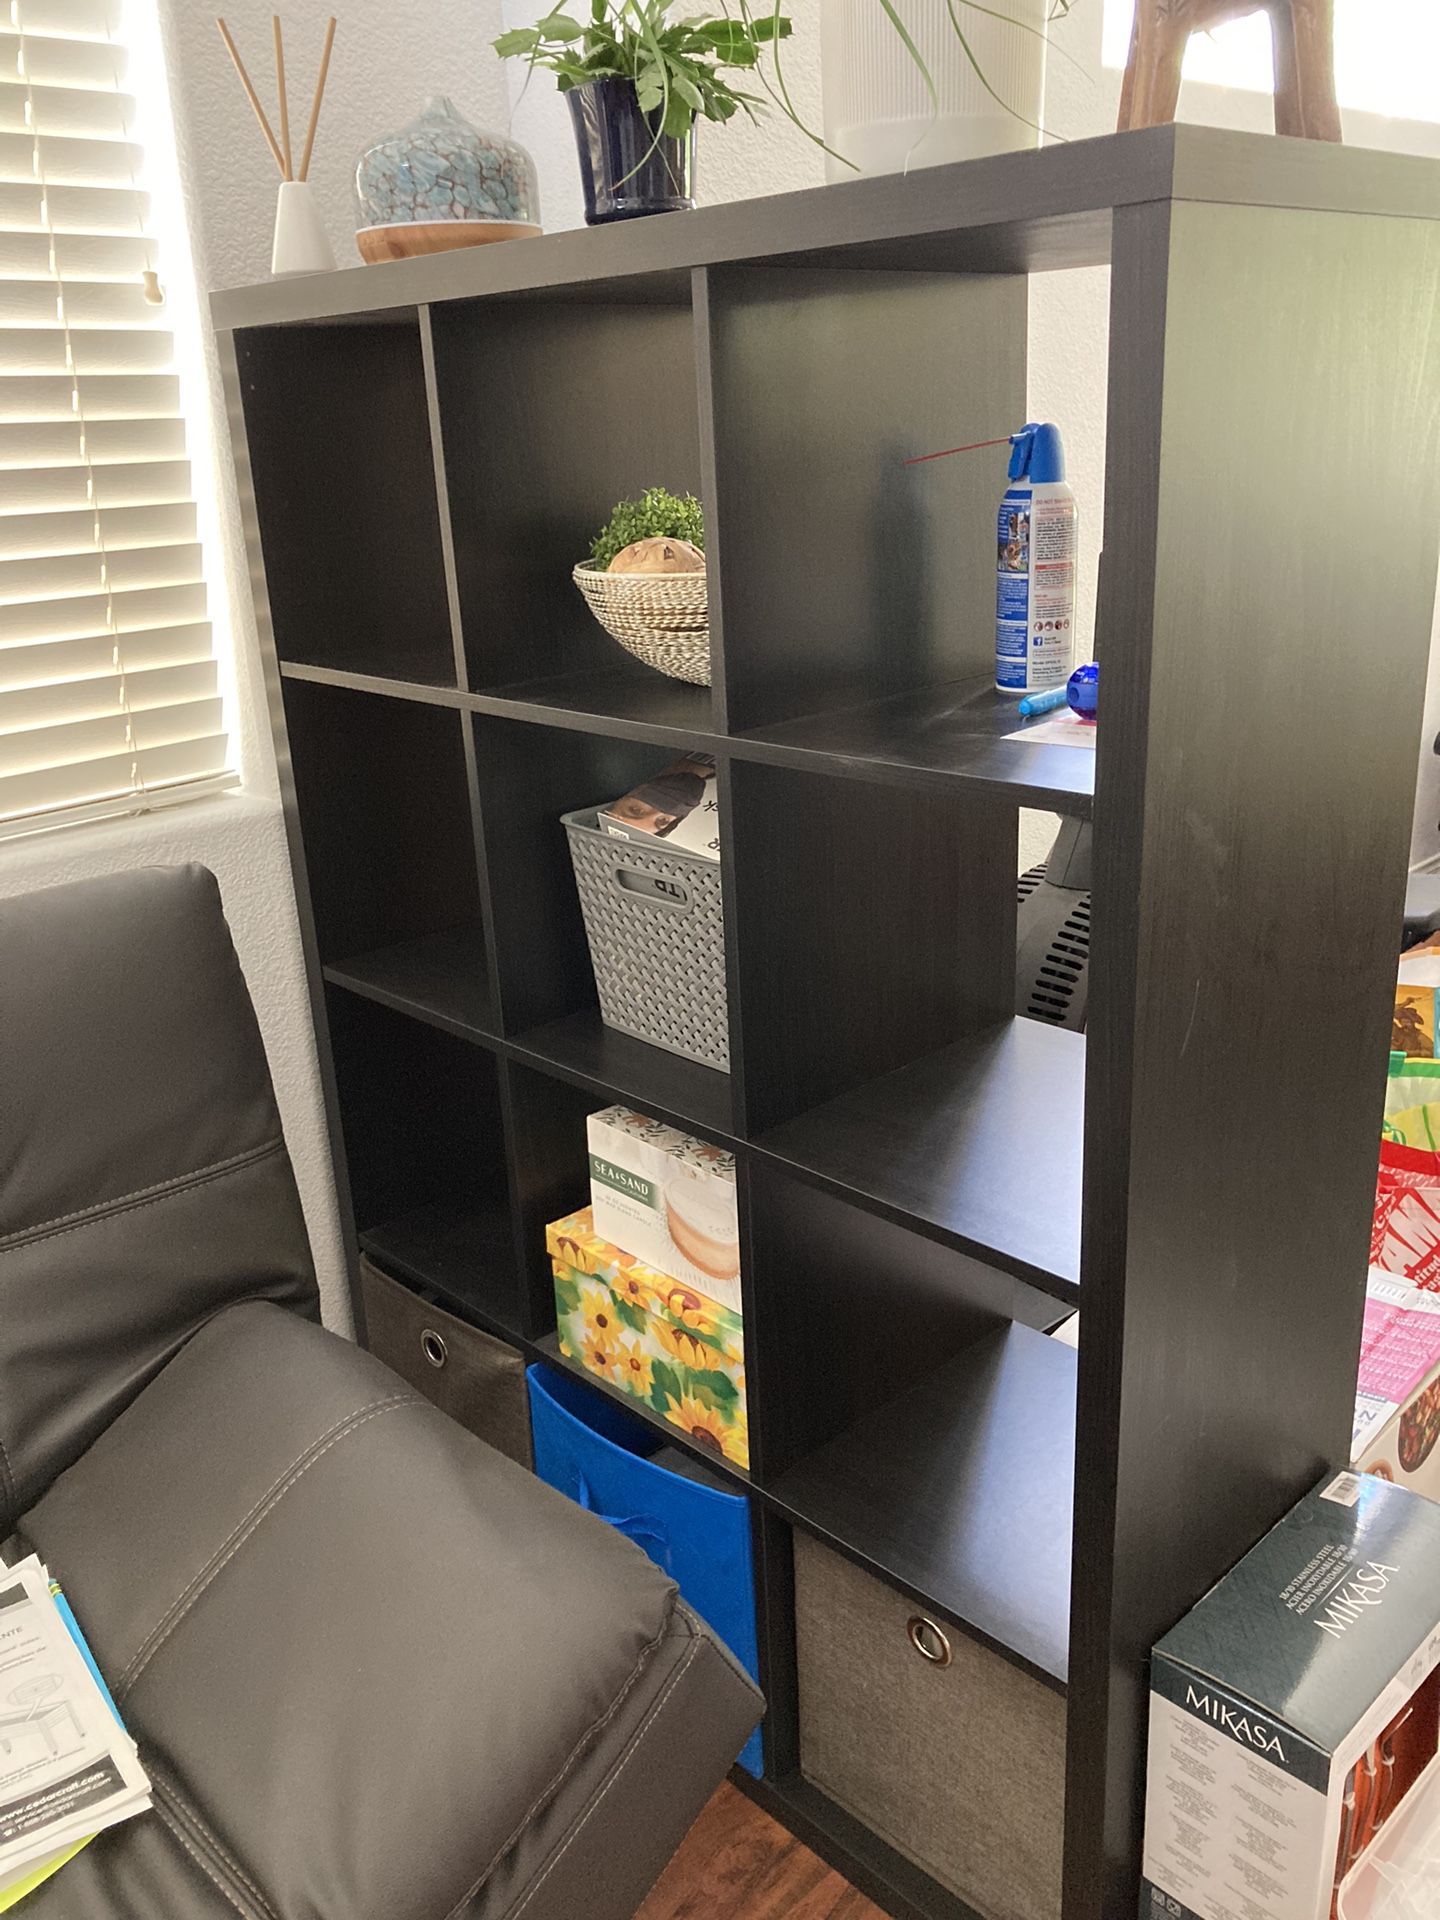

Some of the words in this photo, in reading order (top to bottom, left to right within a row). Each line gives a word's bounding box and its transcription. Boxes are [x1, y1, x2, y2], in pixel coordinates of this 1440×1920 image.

[1286, 1589, 1306, 1610] ACIER
[1301, 1557, 1336, 1593] INOXYDABLE
[1291, 1558, 1321, 1588] STAINLESS
[1316, 1544, 1335, 1561] STEEL
[1296, 1593, 1317, 1615] ACERO
[1314, 1560, 1347, 1596] INOXIDABLE
[1313, 1560, 1399, 1639] MIKASA
[1186, 1684, 1286, 1762] MIKASA
